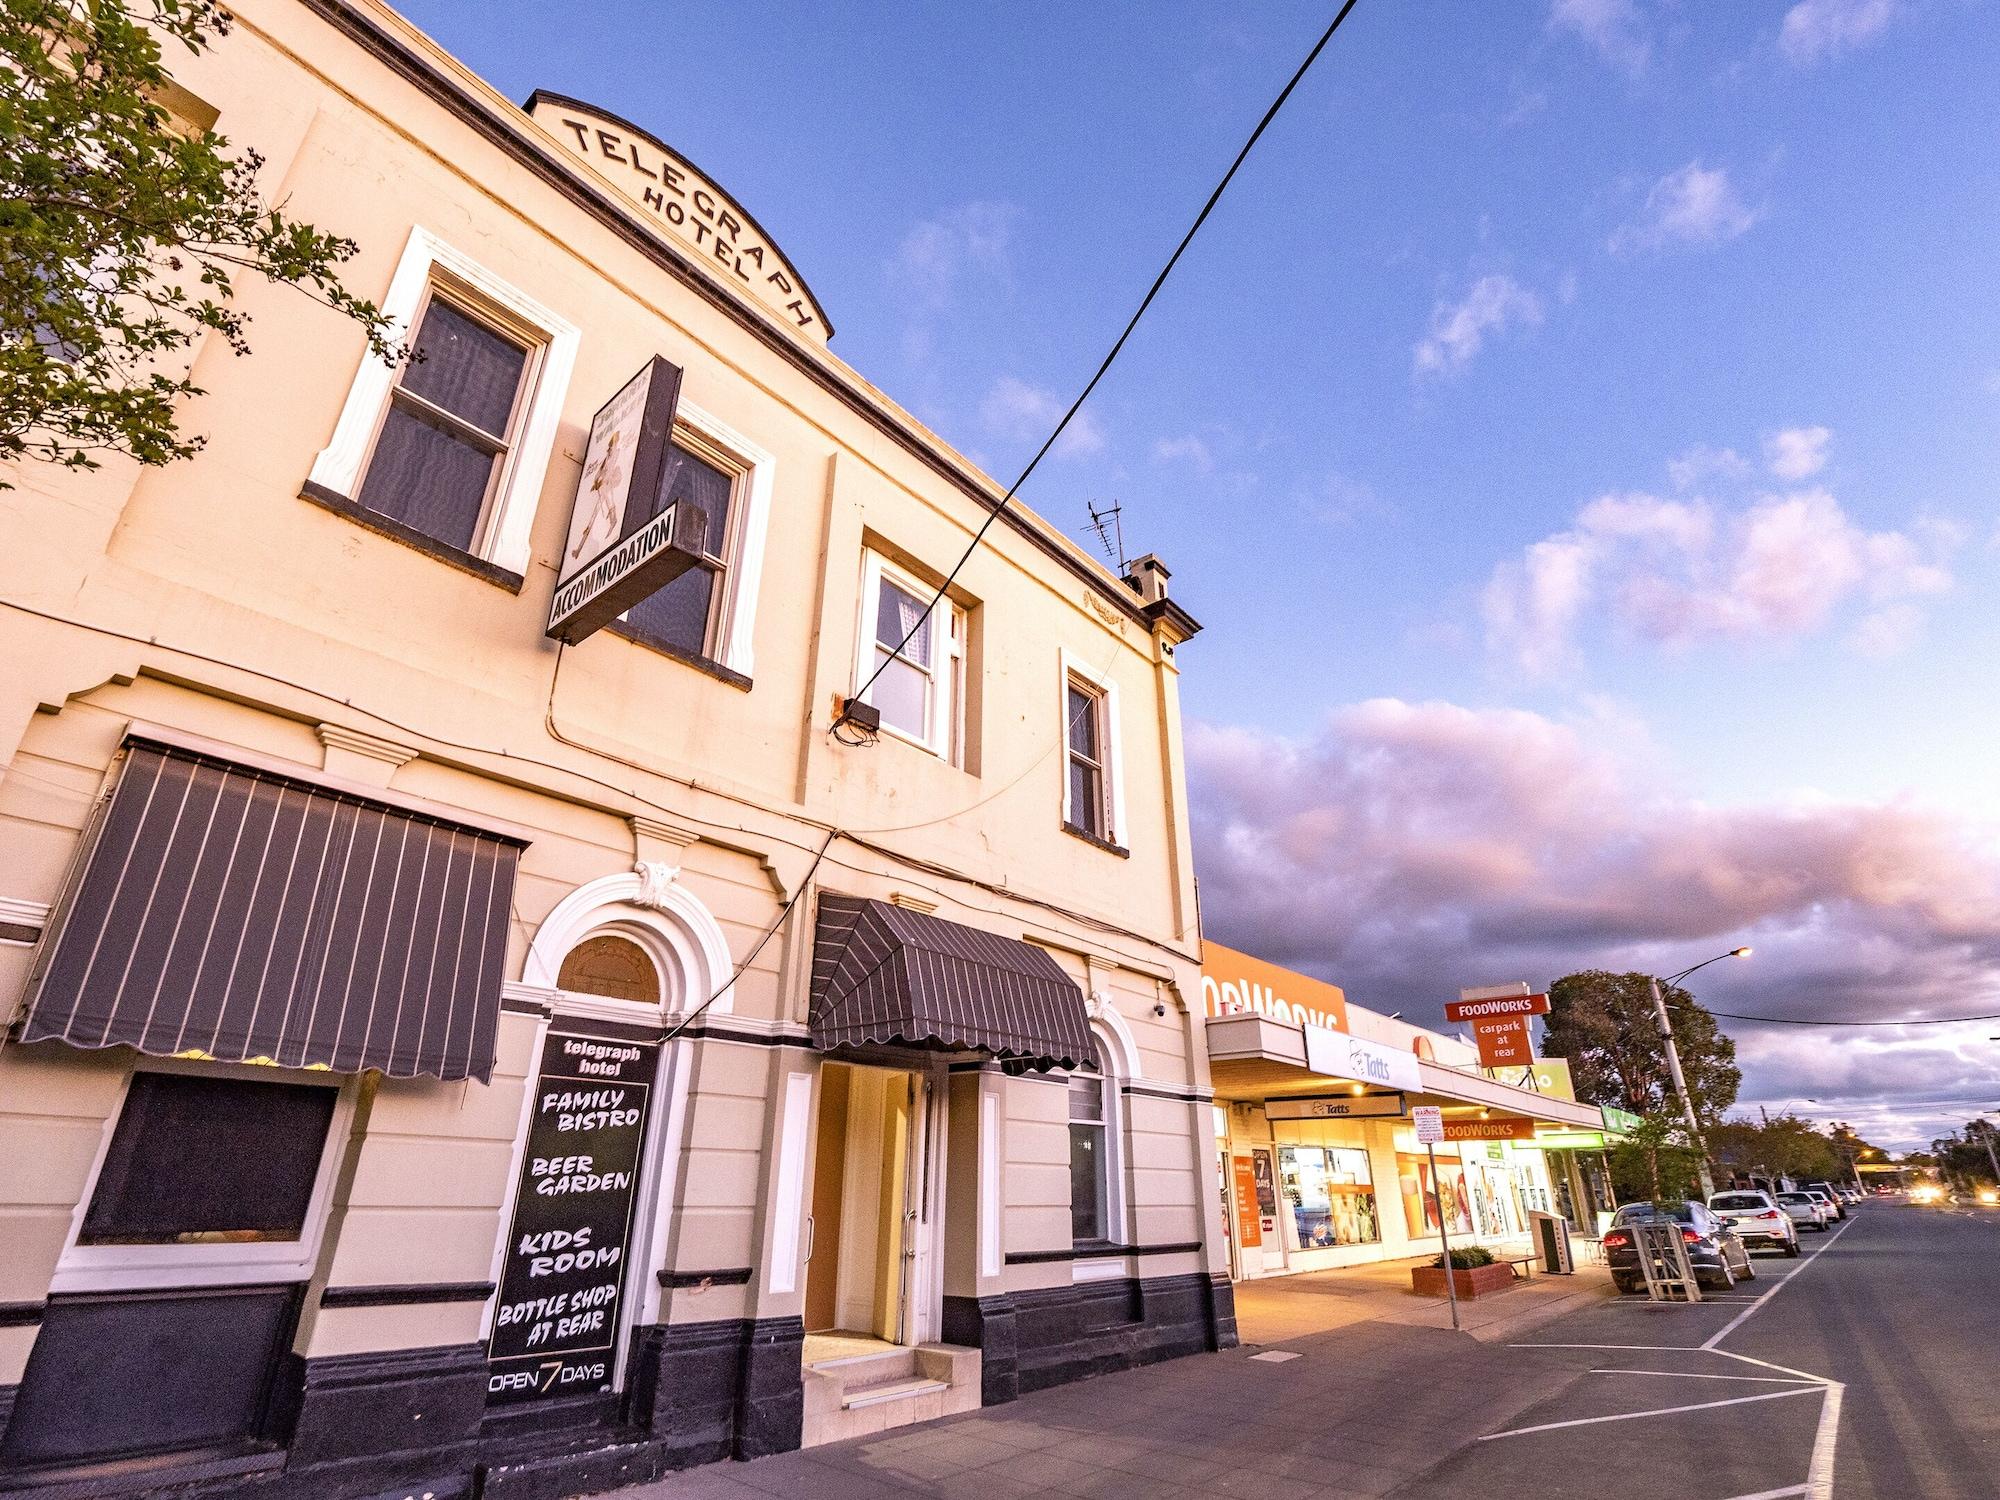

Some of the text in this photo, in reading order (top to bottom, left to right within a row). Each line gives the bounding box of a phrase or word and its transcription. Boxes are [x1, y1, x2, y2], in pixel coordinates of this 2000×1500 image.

[562, 119, 813, 327] TELEGRAPH
[643, 187, 750, 283] HOTEL
[551, 513, 672, 622] ACCOMMODATION
[1459, 999, 1532, 1016] FOODWORKS
[1480, 1021, 1520, 1035] carpark
[1497, 1035, 1508, 1045] at
[563, 1039, 641, 1062] telegraph
[1494, 1048, 1515, 1058] rear
[578, 1058, 621, 1077] hotel
[1363, 1052, 1390, 1080] Tatts
[541, 1089, 625, 1113] FAMILY
[1325, 1104, 1350, 1114] Tatts
[556, 1108, 640, 1132] BISTRO
[531, 1156, 594, 1177] BEER
[1257, 1160, 1265, 1178] 7
[536, 1171, 632, 1197] GARDEN
[1256, 1179, 1270, 1188] DAYS
[518, 1226, 592, 1257] KIDS
[529, 1247, 621, 1278] ROOM
[497, 1284, 618, 1327] BOTTLE SHOP
[526, 1310, 604, 1347] AT REAR
[488, 1361, 605, 1393] OPEN 7 DAYS
